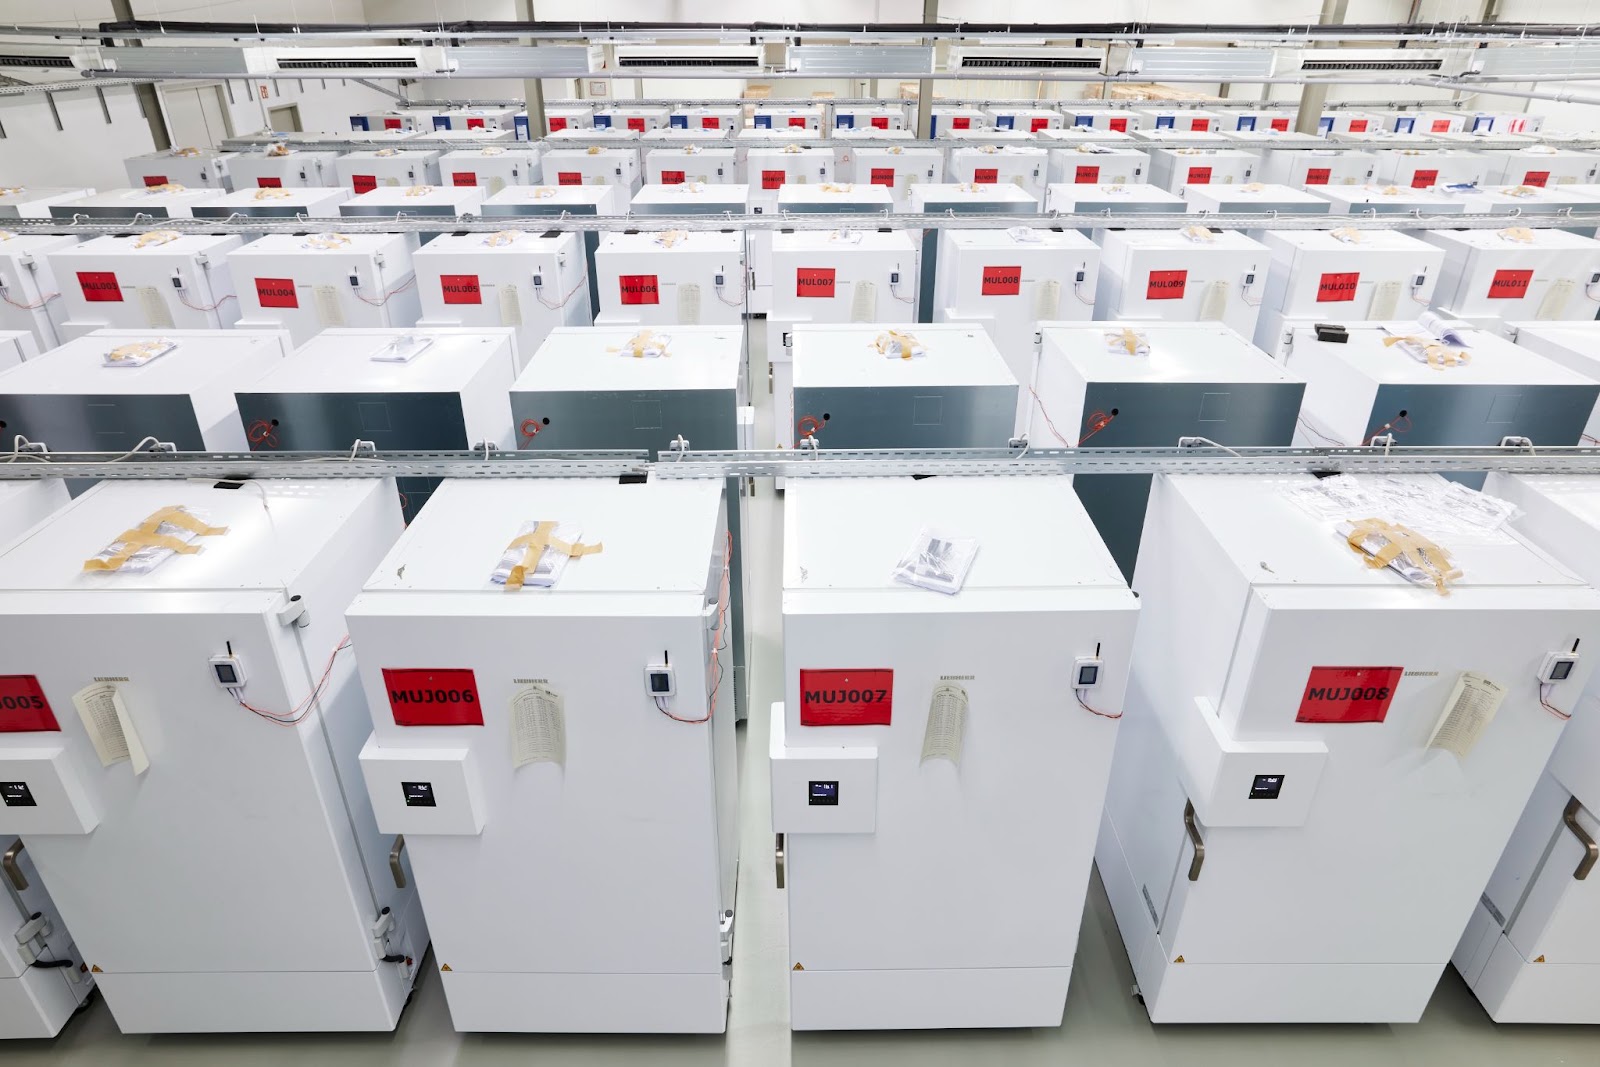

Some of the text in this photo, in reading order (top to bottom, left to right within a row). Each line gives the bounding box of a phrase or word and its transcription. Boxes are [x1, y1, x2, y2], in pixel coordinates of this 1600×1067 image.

[798, 278, 833, 286] MUL007
[984, 276, 1019, 284] MUL008
[1149, 280, 1183, 288] MUL009
[1493, 280, 1527, 288] MUL011
[81, 282, 117, 291] MUL003
[443, 285, 479, 293] MUL005
[621, 285, 657, 293] MUL006
[1320, 282, 1355, 291] MUL010
[258, 288, 294, 297] MUL004
[391, 689, 475, 704] MUJ006
[804, 689, 887, 704] MUJ007
[1306, 687, 1390, 702] MUJ008
[0, 696, 44, 709] 005
